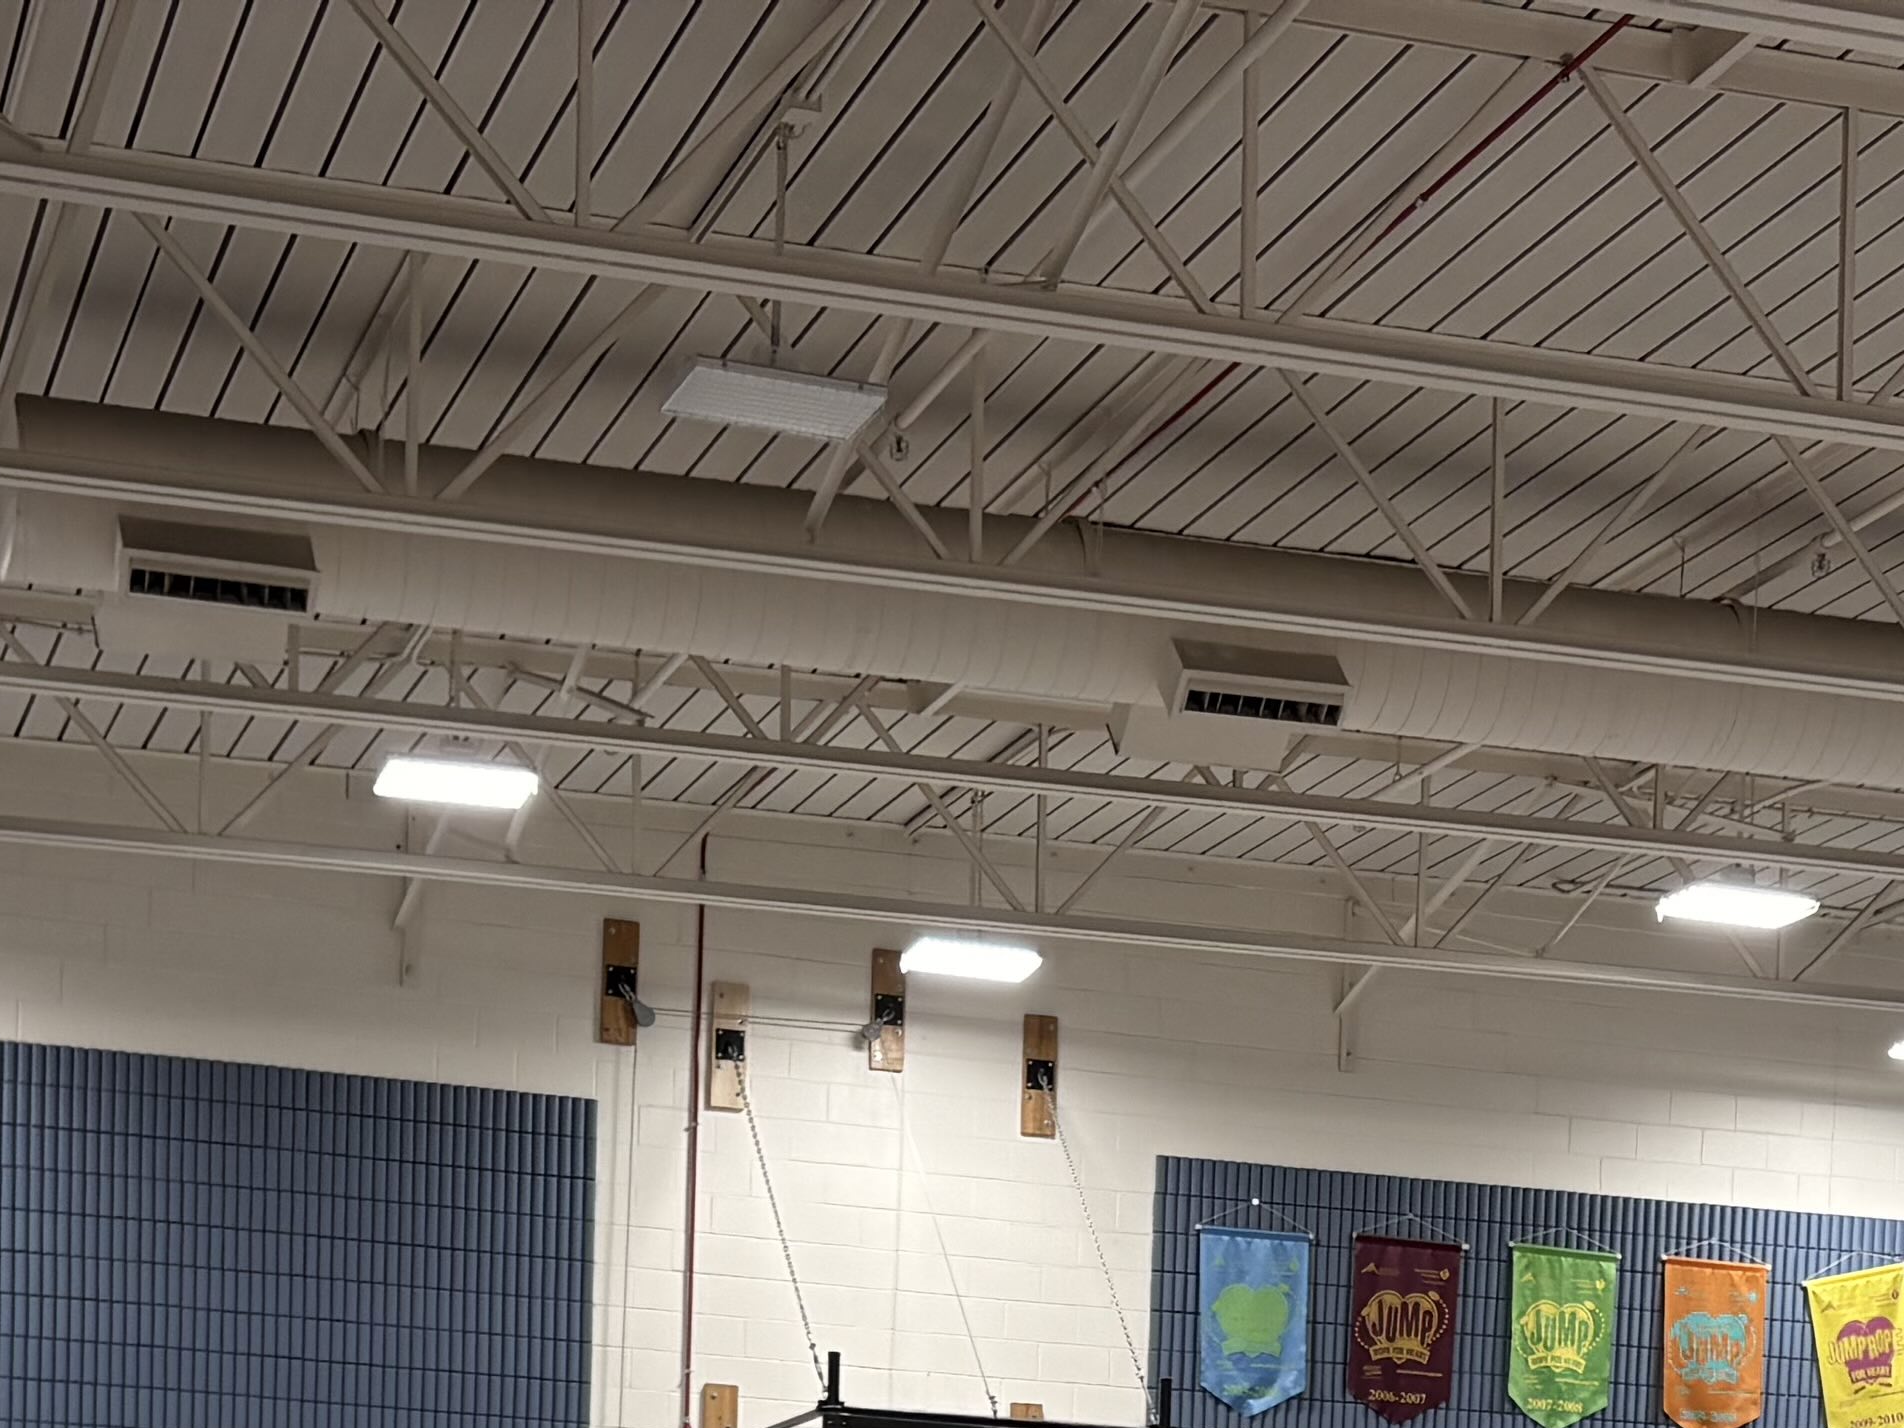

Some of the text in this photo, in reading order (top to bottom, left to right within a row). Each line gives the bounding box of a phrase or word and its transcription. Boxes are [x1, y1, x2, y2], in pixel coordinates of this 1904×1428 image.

[1371, 1301, 1434, 1348] JUMP
[1828, 1328, 1904, 1365] JUMP ROPE
[1369, 1389, 1427, 1405] 2006-2007
